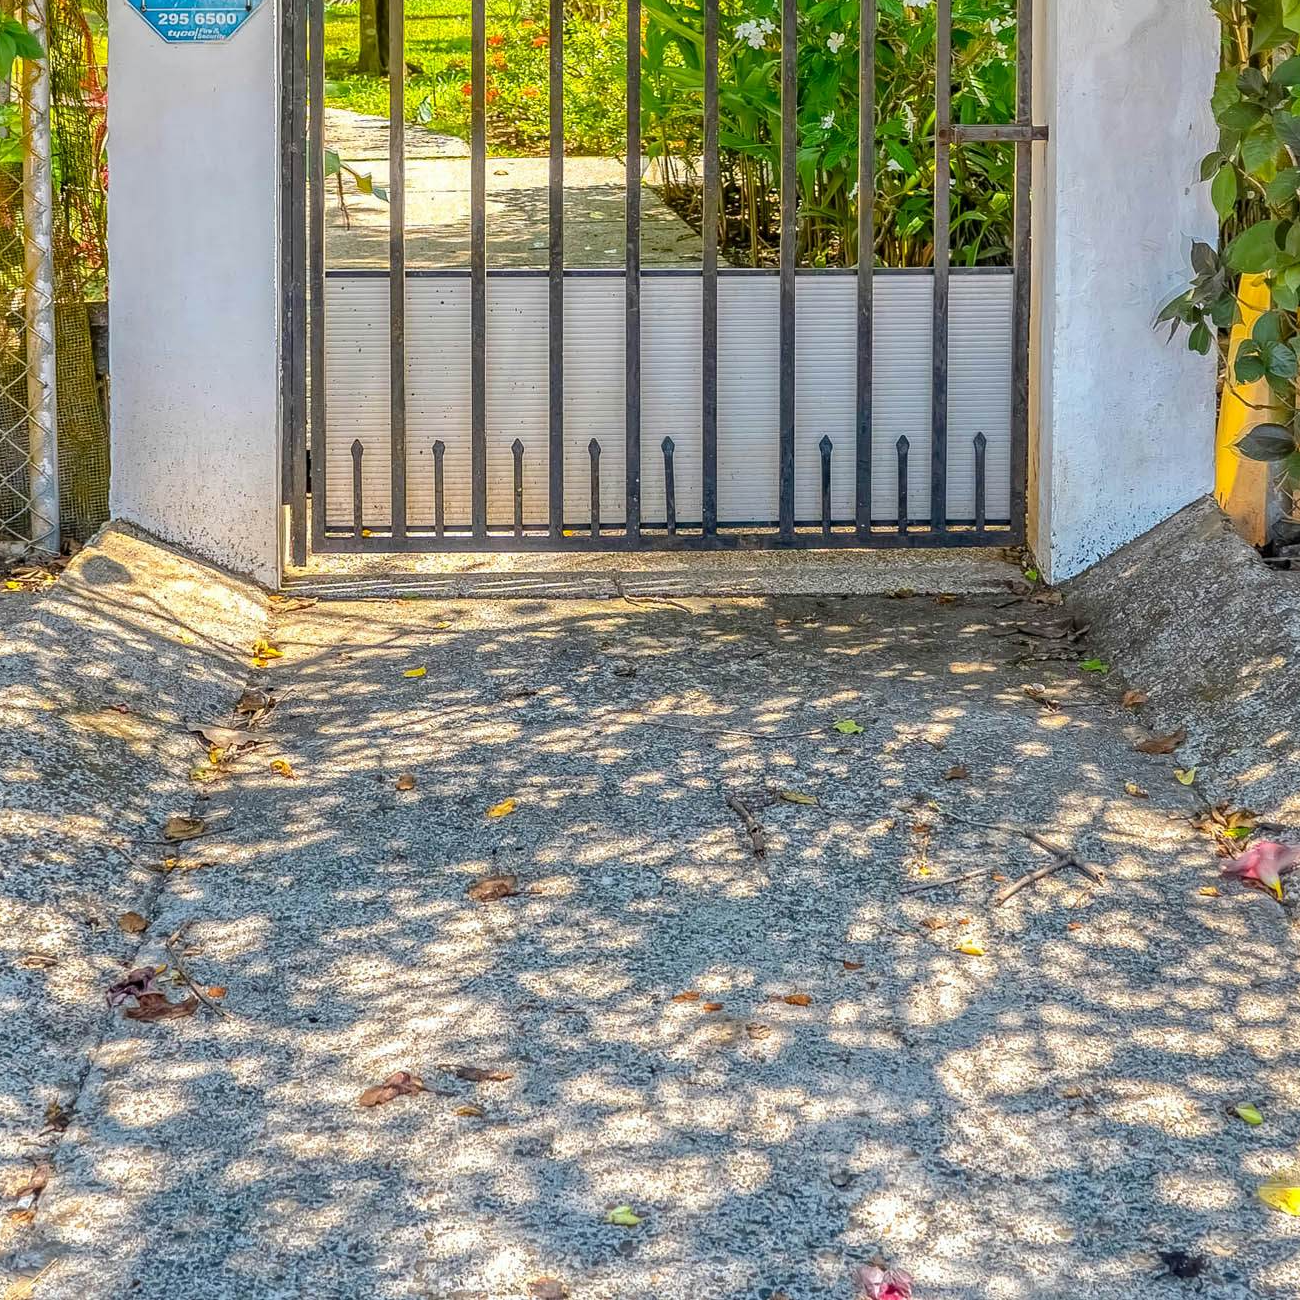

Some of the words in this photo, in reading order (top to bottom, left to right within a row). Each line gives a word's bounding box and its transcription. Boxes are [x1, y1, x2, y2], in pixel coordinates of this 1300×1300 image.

[158, 12, 189, 25] 295
[194, 12, 237, 25] 6500
[167, 29, 195, 38] tyco
